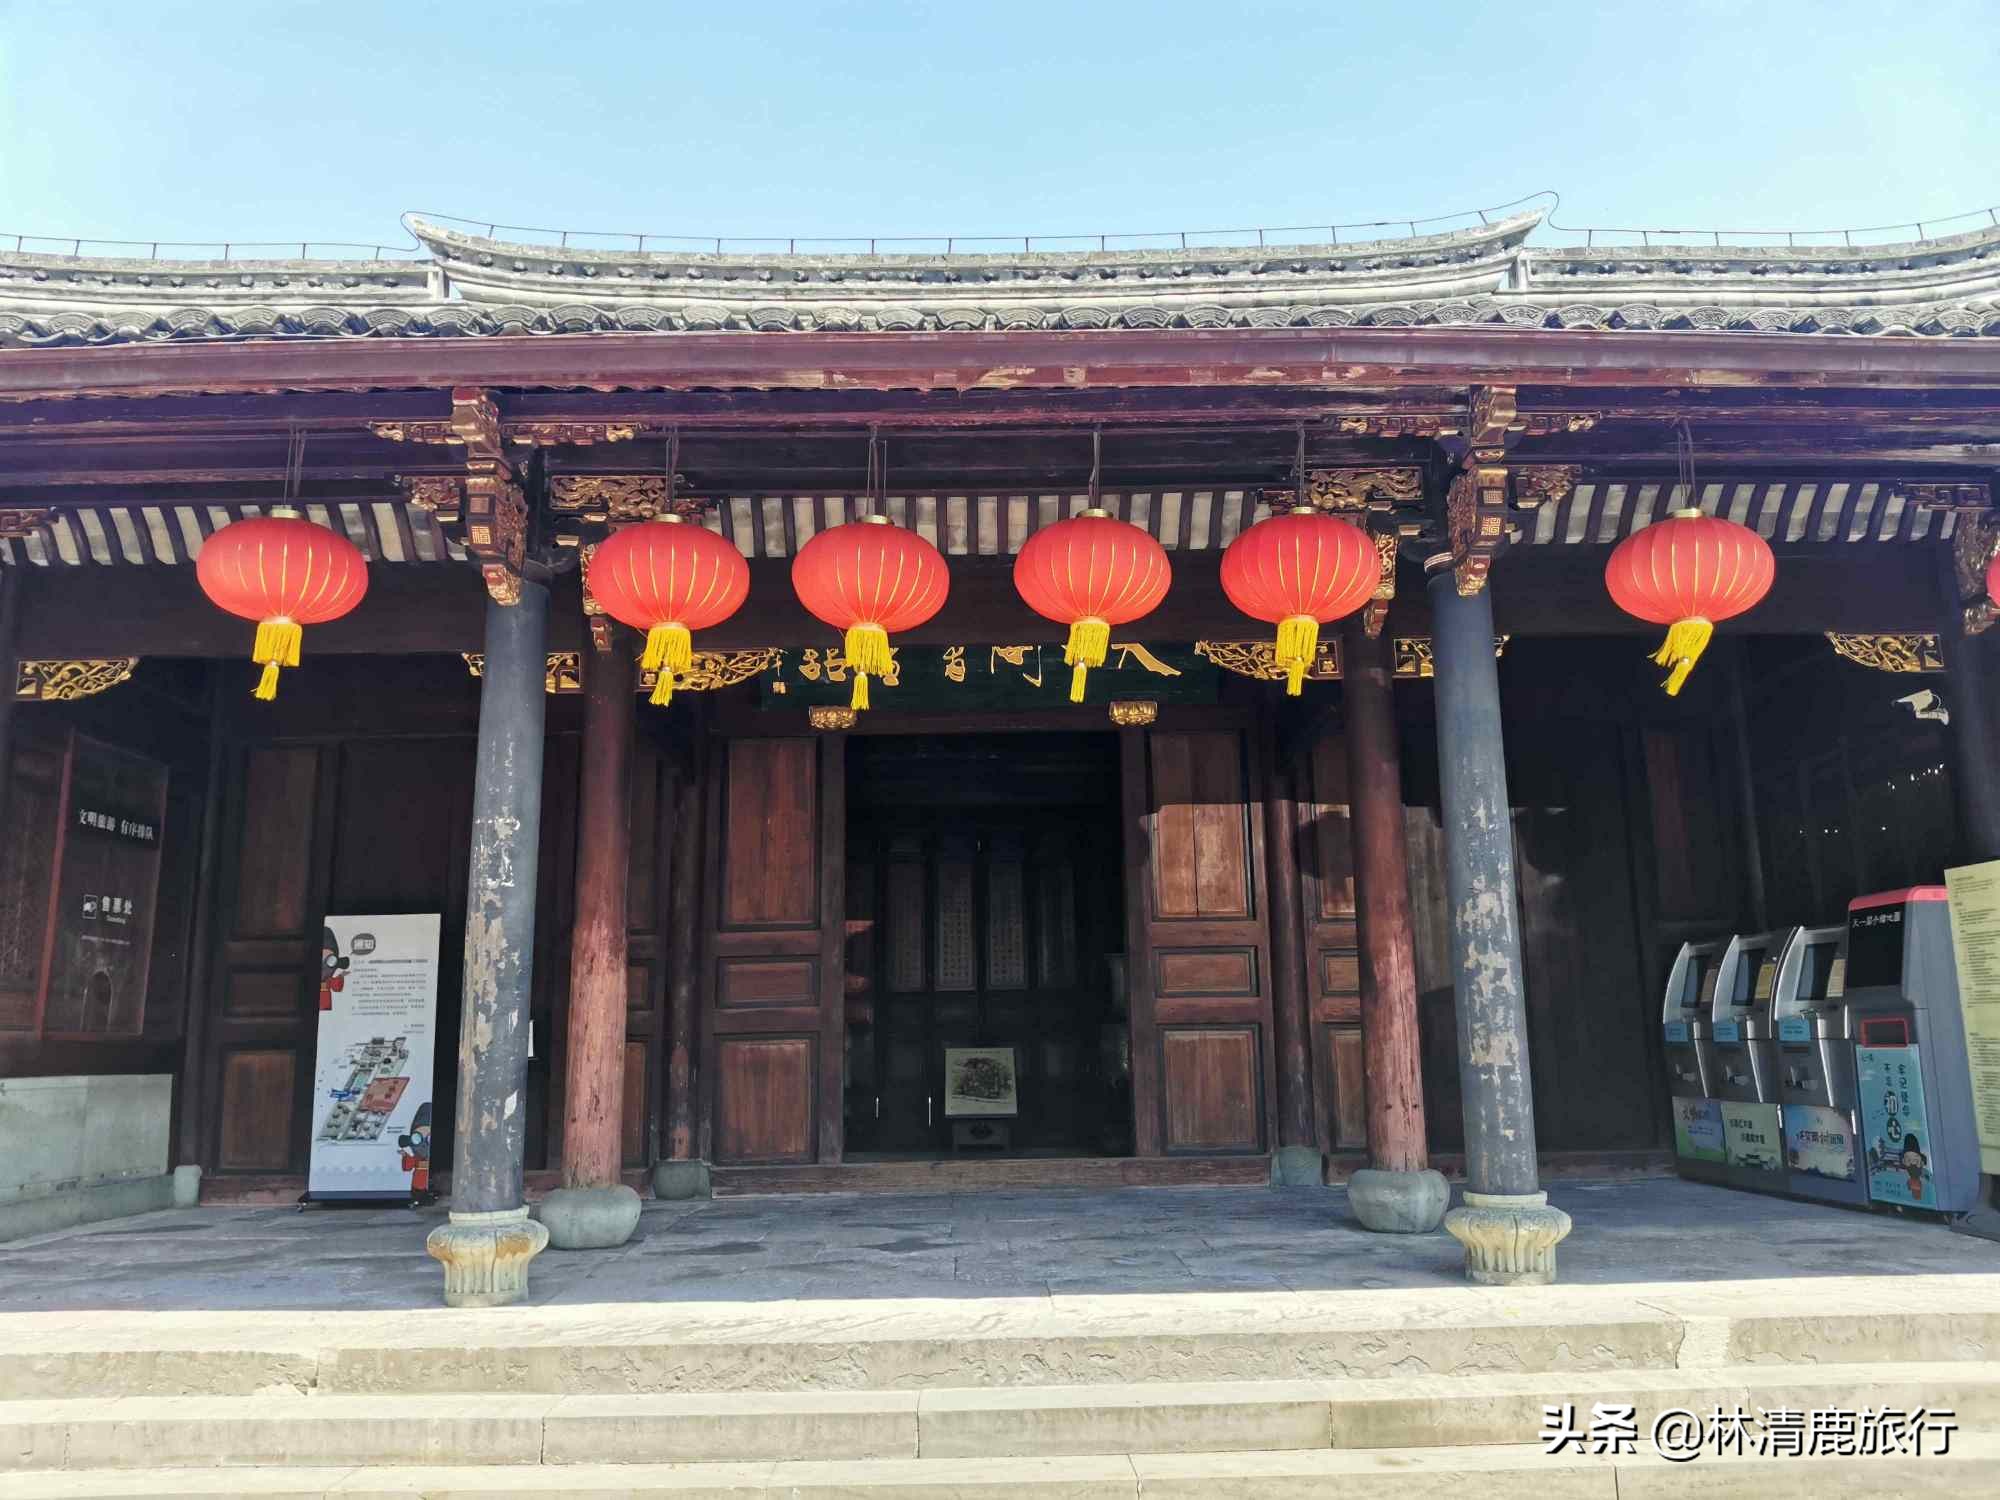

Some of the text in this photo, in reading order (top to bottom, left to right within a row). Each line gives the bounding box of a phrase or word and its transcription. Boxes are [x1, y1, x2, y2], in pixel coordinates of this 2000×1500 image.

[79, 809, 153, 840] 文明旅游 有序排队
[102, 896, 132, 915] 售票处
